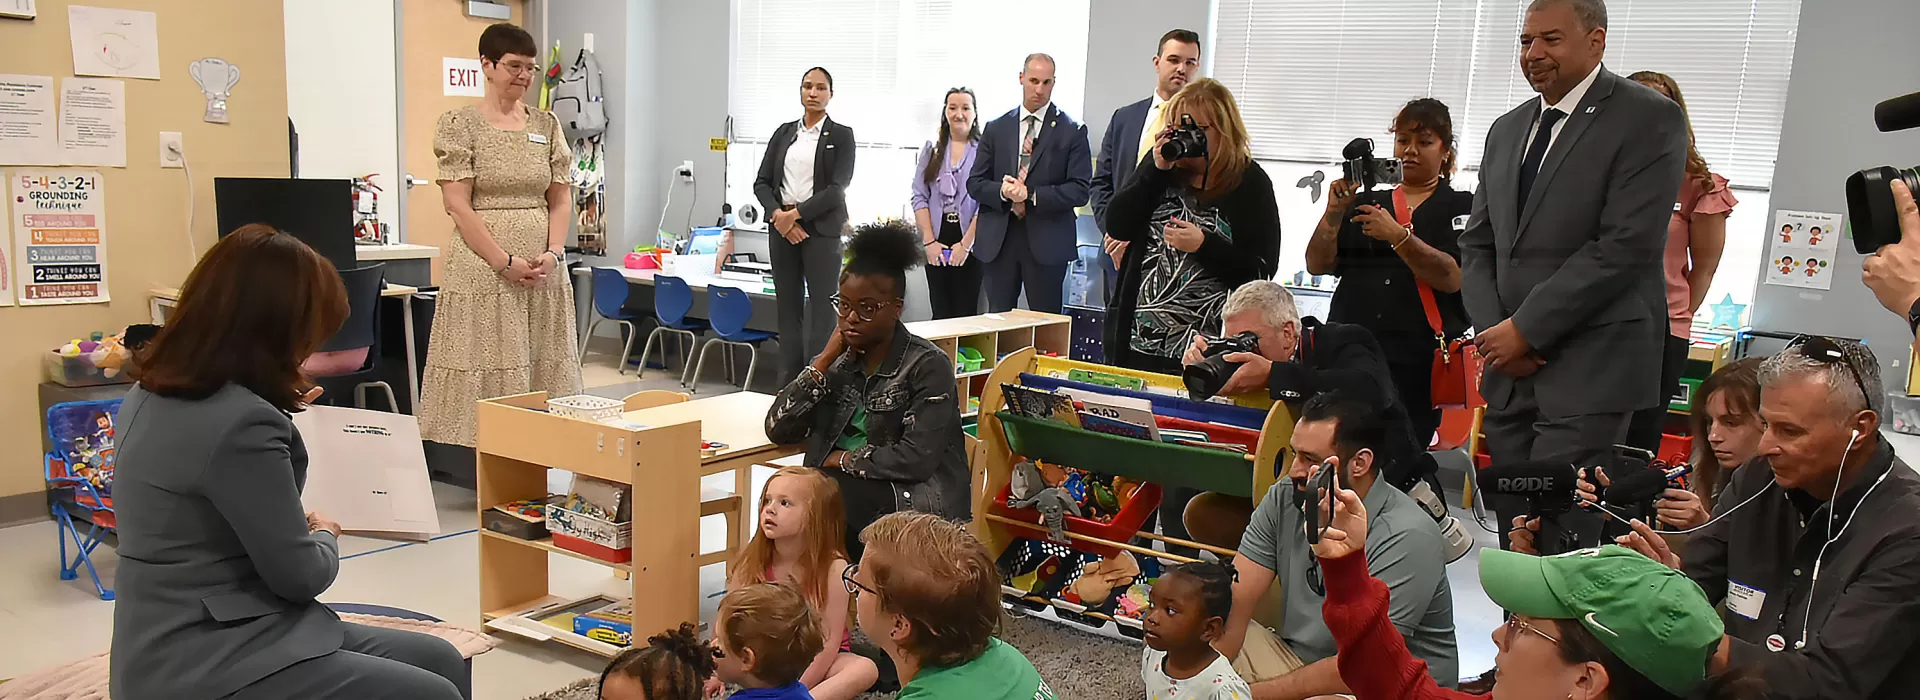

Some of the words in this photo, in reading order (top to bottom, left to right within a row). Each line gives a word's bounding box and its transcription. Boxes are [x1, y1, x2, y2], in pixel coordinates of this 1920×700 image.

[450, 68, 478, 87] EXIT
[22, 176, 95, 190] 5-4-3-2-1
[29, 191, 88, 201] GROUNDING
[36, 200, 82, 212] technique
[24, 215, 33, 226] 5
[34, 231, 43, 242] 4
[31, 249, 39, 261] 3
[35, 268, 45, 280] 2
[30, 286, 39, 298] 1
[1498, 477, 1554, 491] RØDE
